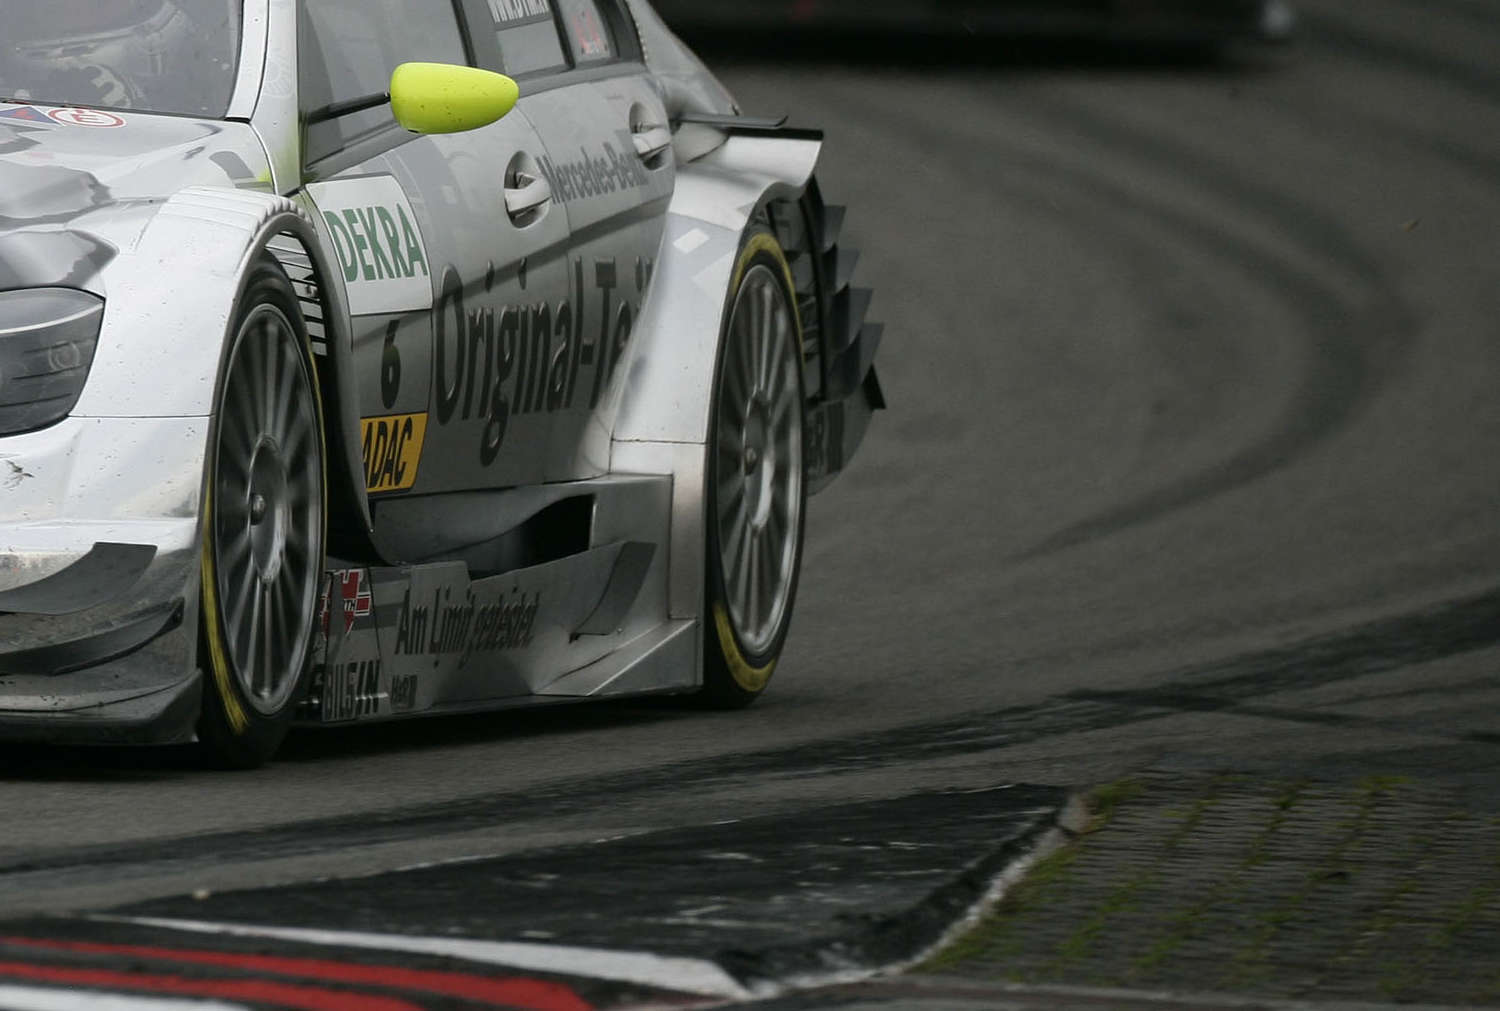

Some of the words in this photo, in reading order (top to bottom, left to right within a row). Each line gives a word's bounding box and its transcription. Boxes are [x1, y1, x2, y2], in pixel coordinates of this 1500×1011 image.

[323, 202, 428, 282] DEKRA
[381, 319, 401, 409] 6
[362, 417, 414, 489] ADAC
[395, 587, 428, 655] Am
